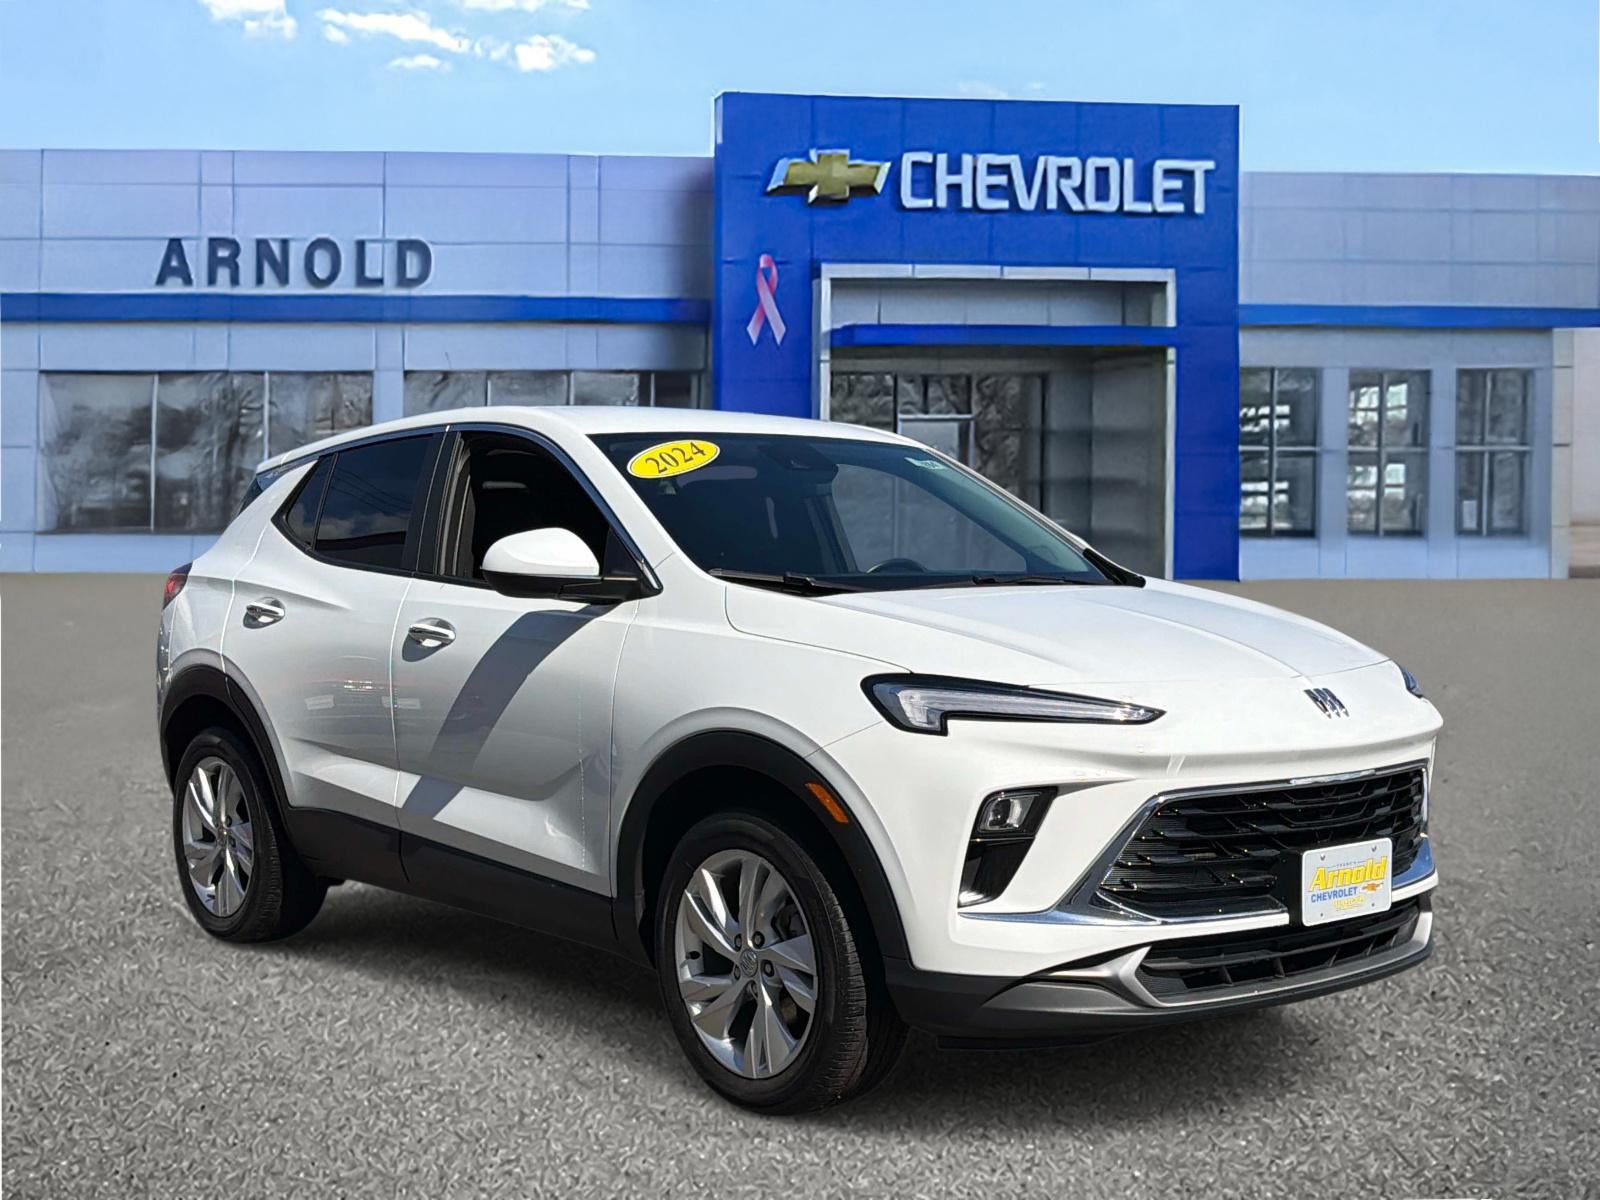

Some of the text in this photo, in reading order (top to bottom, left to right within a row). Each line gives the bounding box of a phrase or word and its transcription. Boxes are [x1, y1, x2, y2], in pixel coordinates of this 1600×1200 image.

[901, 152, 1215, 214] CHEVROLET
[155, 237, 432, 288] ARNOLD
[645, 442, 706, 474] 2024
[1308, 856, 1387, 892] Arnold
[1311, 887, 1358, 903] CHEVROLET
